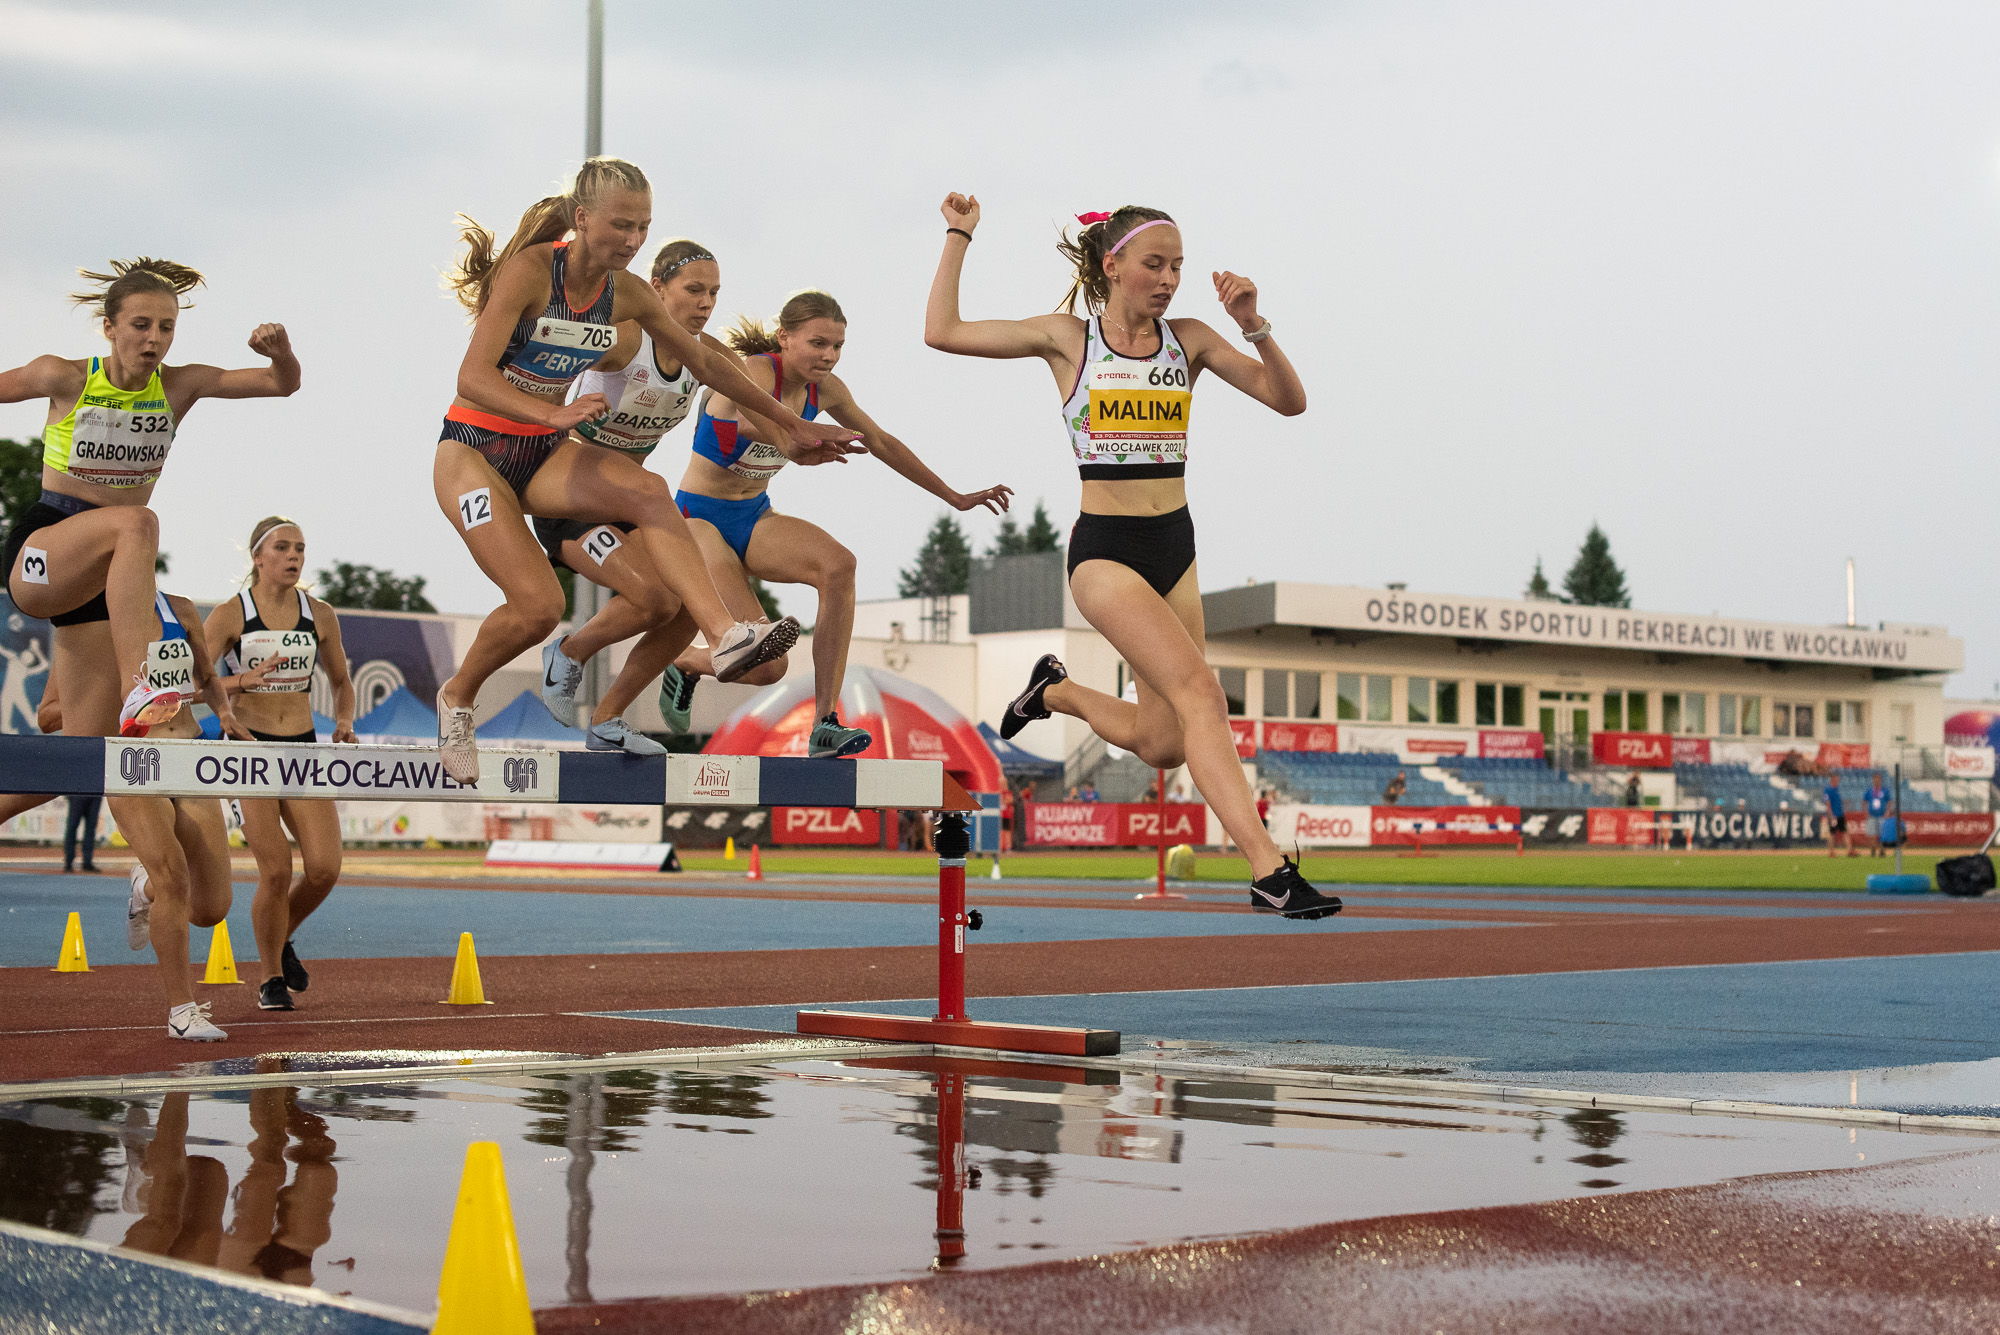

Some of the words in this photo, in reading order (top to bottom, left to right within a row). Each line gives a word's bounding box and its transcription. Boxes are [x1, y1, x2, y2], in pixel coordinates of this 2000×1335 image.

[581, 327, 612, 348] 705
[533, 352, 594, 372] PERYT
[1148, 367, 1186, 387] 660
[1100, 400, 1182, 421] MALINA
[129, 416, 168, 433] 532
[76, 440, 165, 462] GRABOWSKA
[1096, 442, 1162, 452] WŁOCŁAWEK
[461, 494, 490, 523] 12
[588, 530, 616, 559] 10
[25, 556, 45, 577] 3
[1366, 596, 1488, 630] OŚRODEK
[1500, 609, 1592, 638] SPORTU
[1602, 616, 1608, 638] I
[1617, 618, 1735, 648] REKREACJI
[1744, 629, 1775, 650] WE
[1784, 630, 1908, 661] WŁOCŁAWKU
[158, 642, 190, 660] 631
[282, 634, 312, 647] 641
[248, 656, 309, 673] GBEK
[149, 668, 191, 689] ŃSKA
[1617, 739, 1664, 759] PZLA
[195, 756, 270, 785] OSIR
[694, 764, 731, 787] Anwil
[787, 808, 862, 834] PZLA
[1034, 807, 1094, 822] KUJAWY
[1129, 813, 1193, 836] PZLA
[1295, 812, 1352, 838] Reeco
[1034, 825, 1106, 843] POMORZE
[1557, 814, 1583, 837] 4F
[1679, 812, 1814, 840] WŁOCŁAWEK
